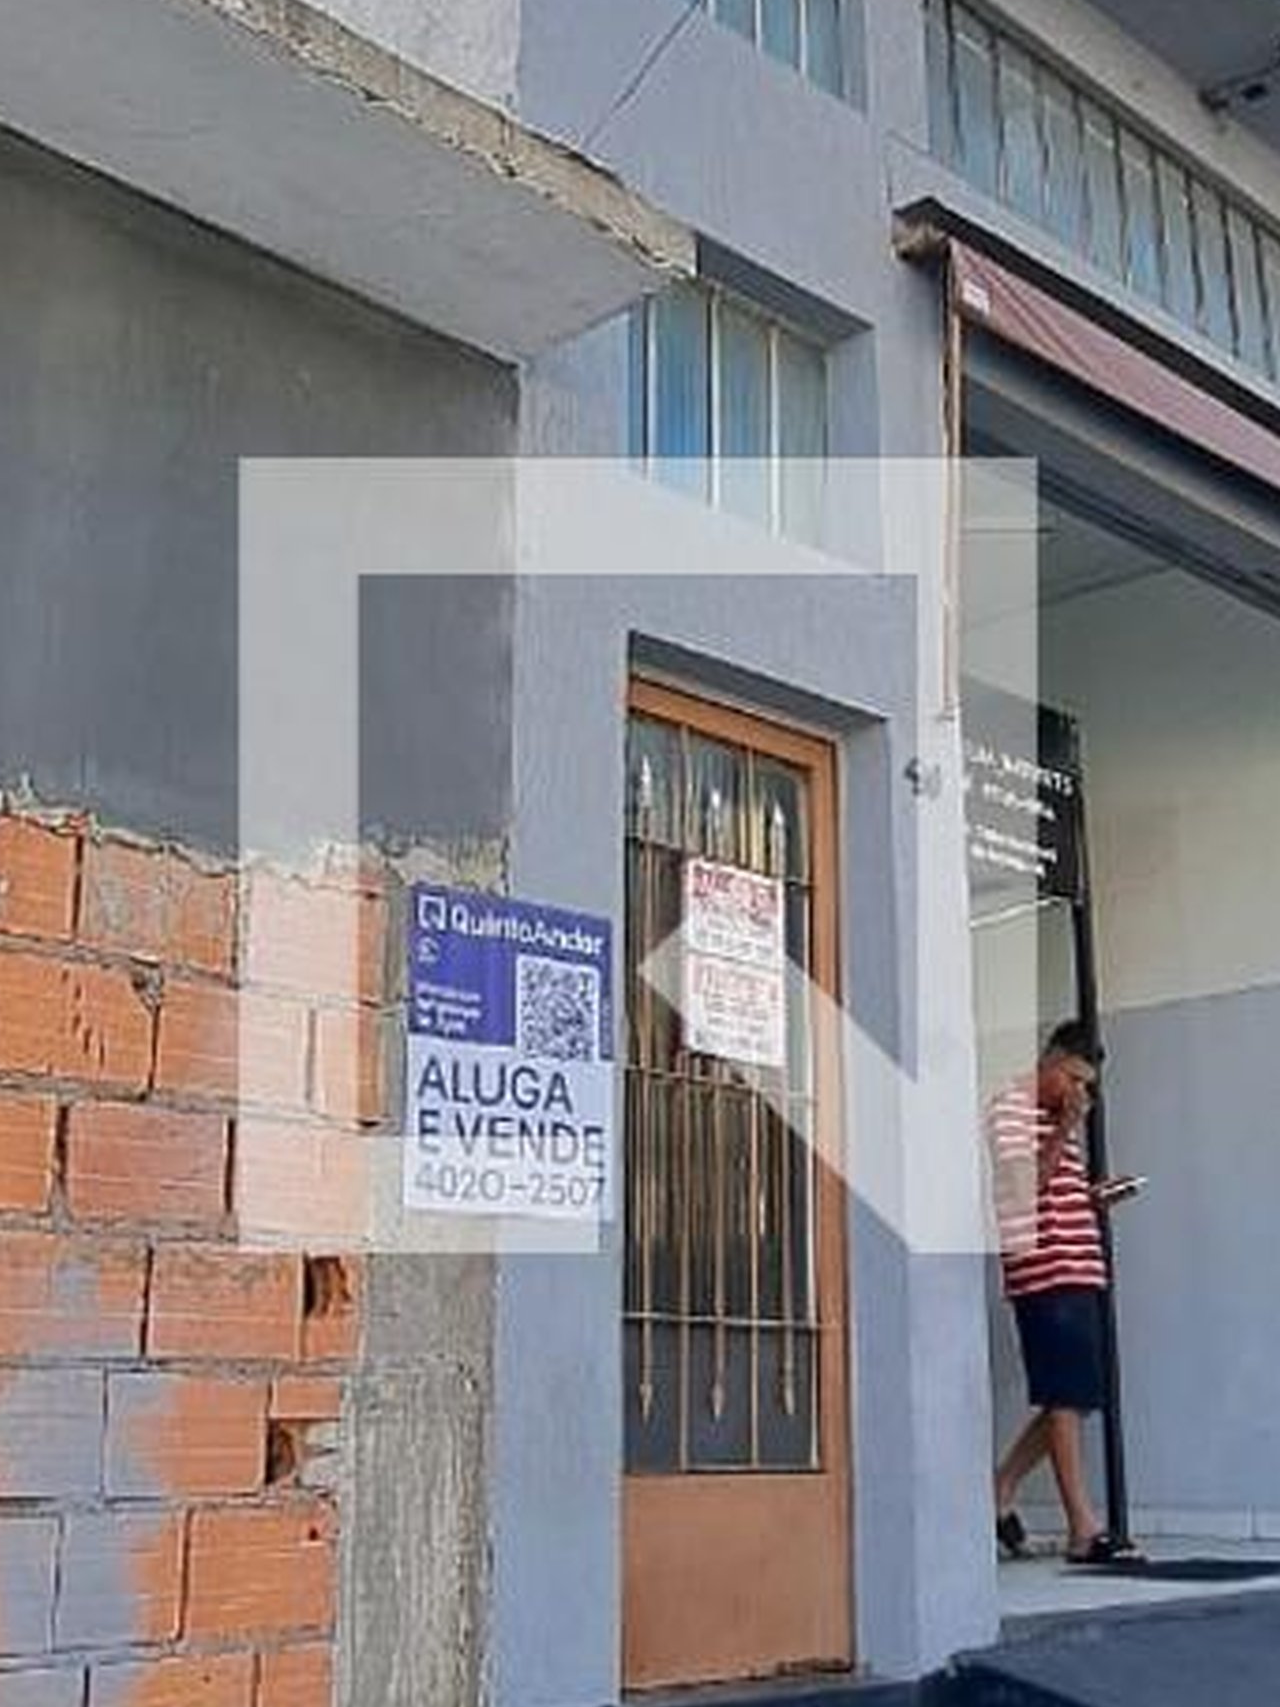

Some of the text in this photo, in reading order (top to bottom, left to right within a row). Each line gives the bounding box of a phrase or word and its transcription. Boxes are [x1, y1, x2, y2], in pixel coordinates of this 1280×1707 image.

[451, 902, 604, 955] QuintoAndar
[418, 1054, 574, 1115] ALUGA
[419, 1108, 606, 1169] E VENDE
[414, 1161, 606, 1206] 4020-2507
